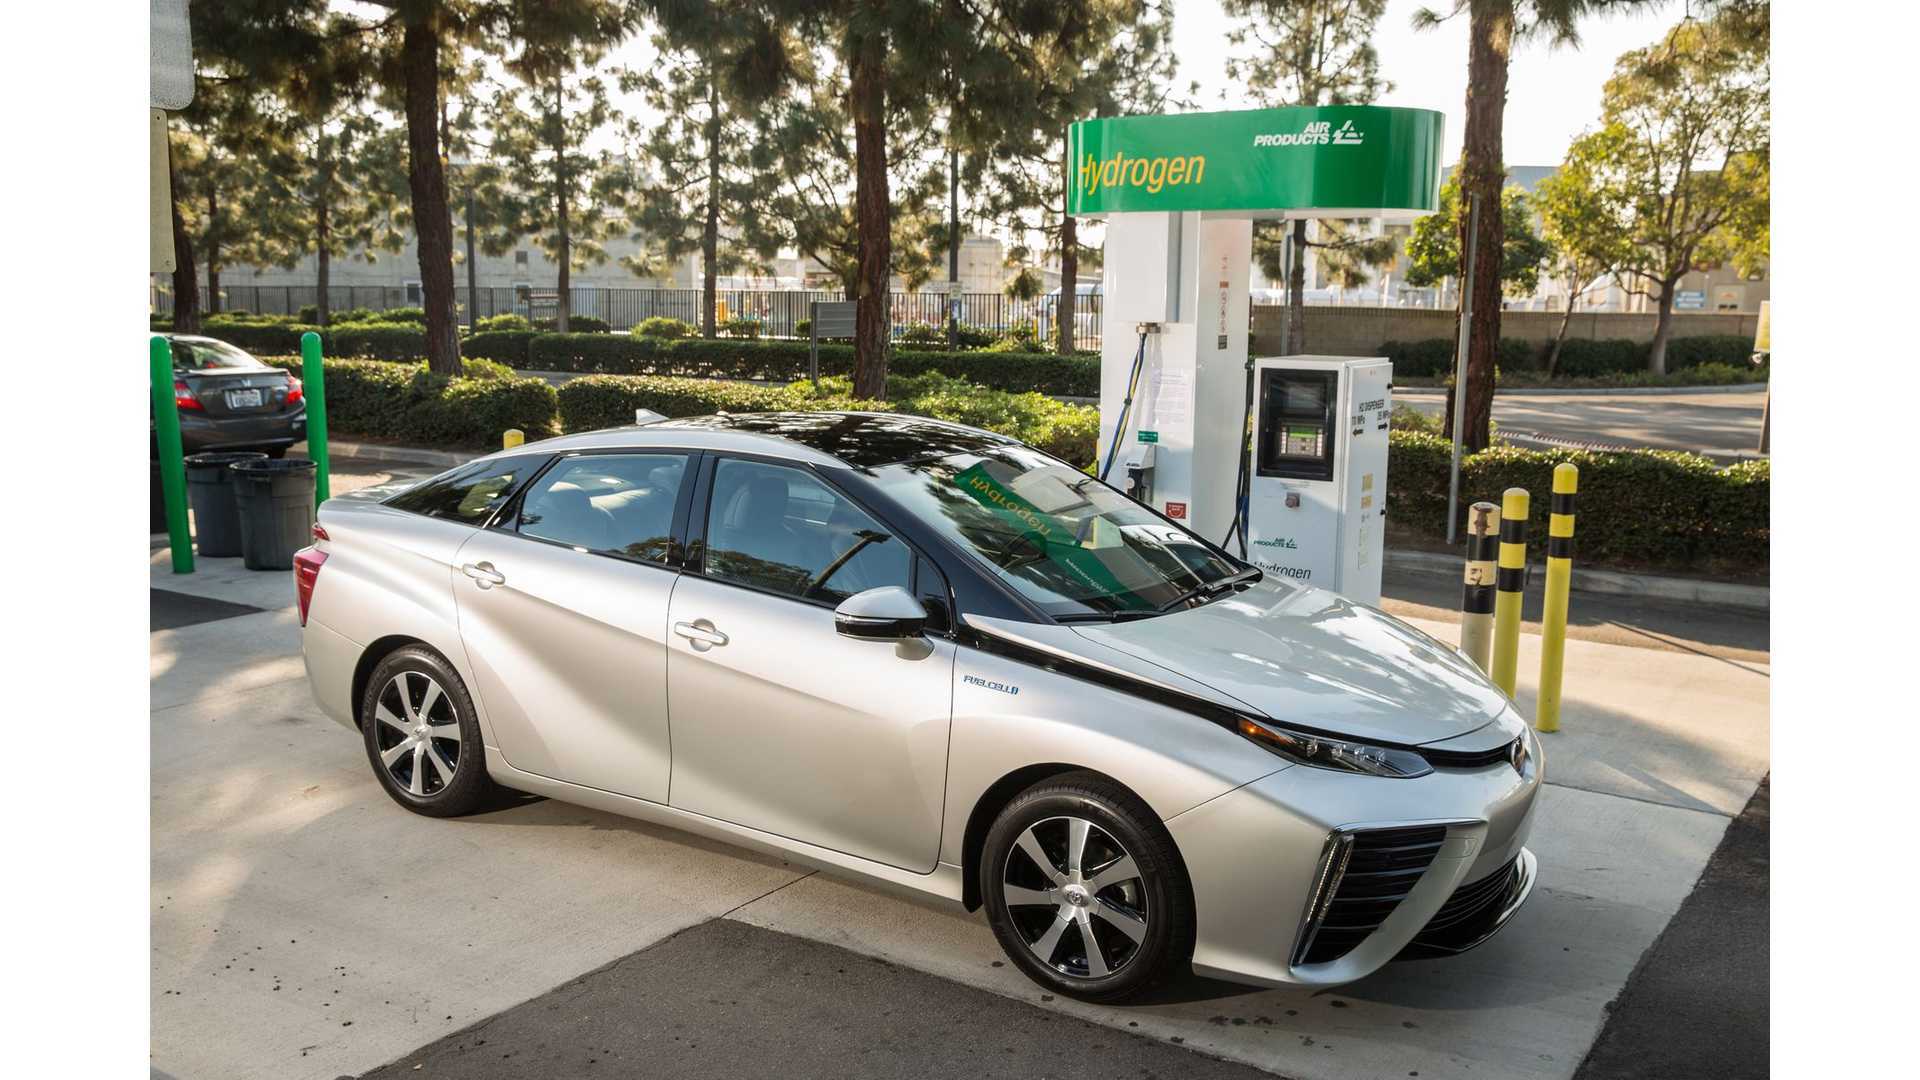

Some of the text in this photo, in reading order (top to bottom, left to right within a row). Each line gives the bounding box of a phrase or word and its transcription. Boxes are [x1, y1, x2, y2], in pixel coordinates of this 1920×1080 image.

[1303, 121, 1331, 134] AIR
[1254, 132, 1330, 147] PRODUCTS
[1079, 151, 1206, 196] Hydrogen
